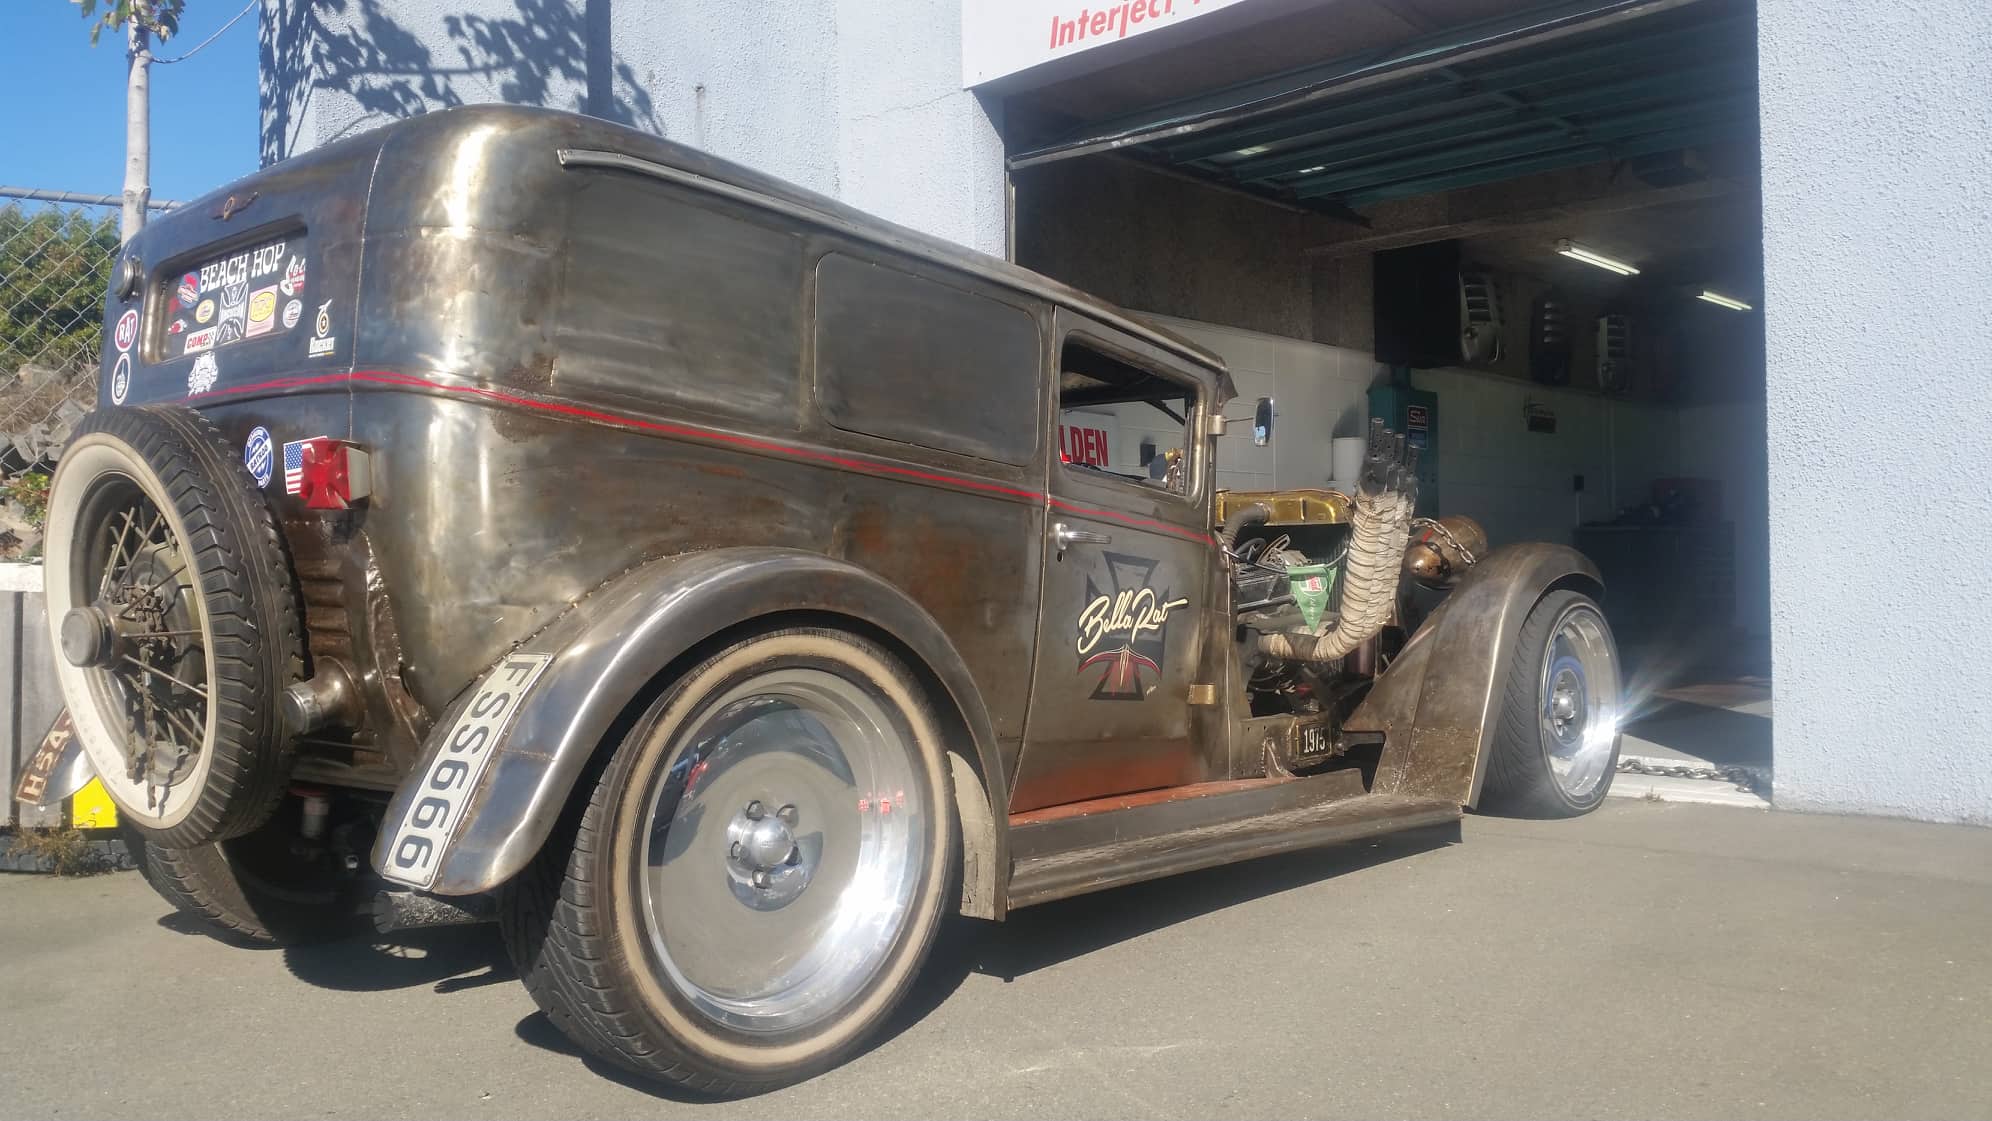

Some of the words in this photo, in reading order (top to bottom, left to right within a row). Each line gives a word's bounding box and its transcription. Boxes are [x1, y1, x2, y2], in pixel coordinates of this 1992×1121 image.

[200, 253, 249, 293] BEACH
[251, 242, 286, 278] HOP
[119, 316, 135, 343] RAT
[186, 333, 208, 349] COMP
[1059, 425, 1109, 467] LDEN
[1077, 590, 1133, 654] Bella
[1132, 588, 1188, 645] Rat
[1303, 727, 1326, 753] 1975
[395, 661, 537, 869] FSS666
